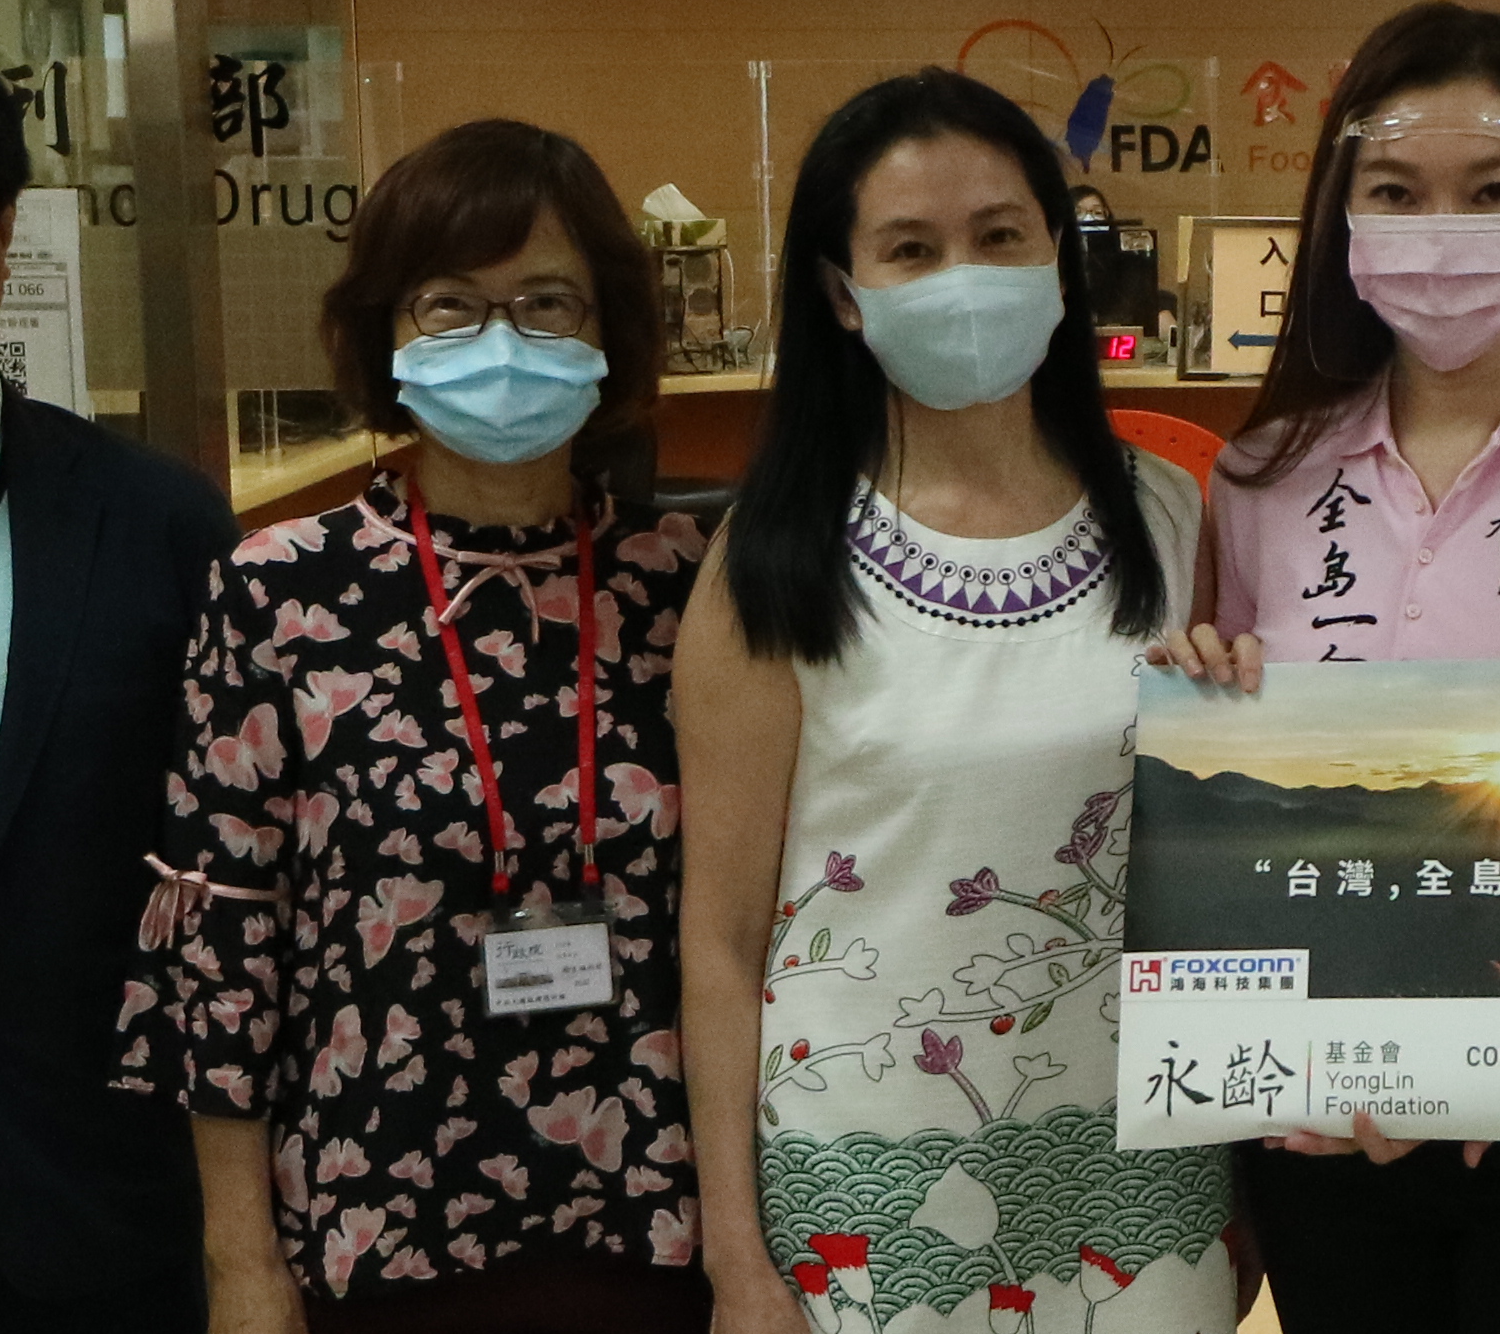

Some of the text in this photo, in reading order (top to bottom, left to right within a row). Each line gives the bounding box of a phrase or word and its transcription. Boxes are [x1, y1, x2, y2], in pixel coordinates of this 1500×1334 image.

[1110, 123, 1225, 173] FDA
[1259, 236, 1289, 317] 入口
[1109, 335, 1136, 358] 12
[1170, 975, 1295, 992] 鴻海科技集團
[1325, 1041, 1402, 1064] 基金會
[1144, 1039, 1297, 1118] 永齡
[1325, 1071, 1415, 1095] YongLin
[1325, 1096, 1451, 1117] Foundation
